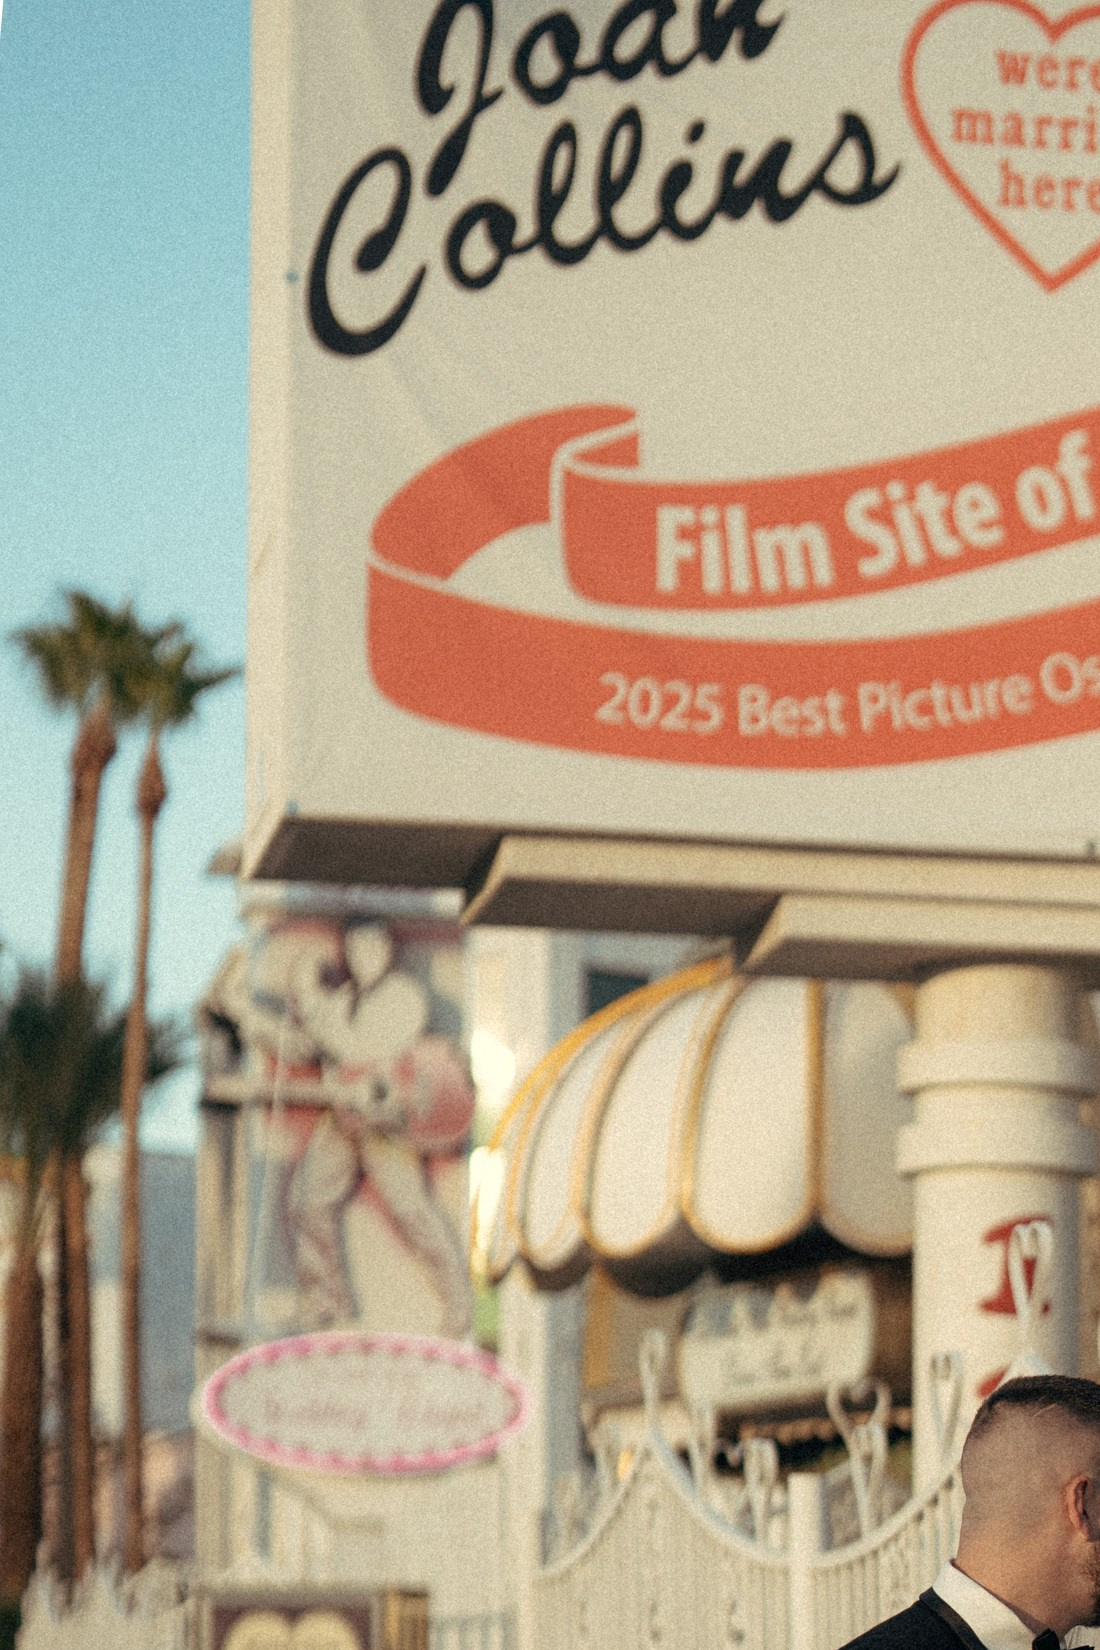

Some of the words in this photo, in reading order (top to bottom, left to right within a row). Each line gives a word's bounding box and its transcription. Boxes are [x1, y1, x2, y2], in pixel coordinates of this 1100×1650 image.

[414, 0, 784, 197] Joan
[306, 105, 901, 358] Collins
[655, 503, 834, 595] Film
[844, 480, 1005, 578] Site
[1015, 429, 1096, 532] of
[596, 671, 724, 734] 2025
[737, 683, 847, 739] Best
[857, 674, 1033, 737] Picture
